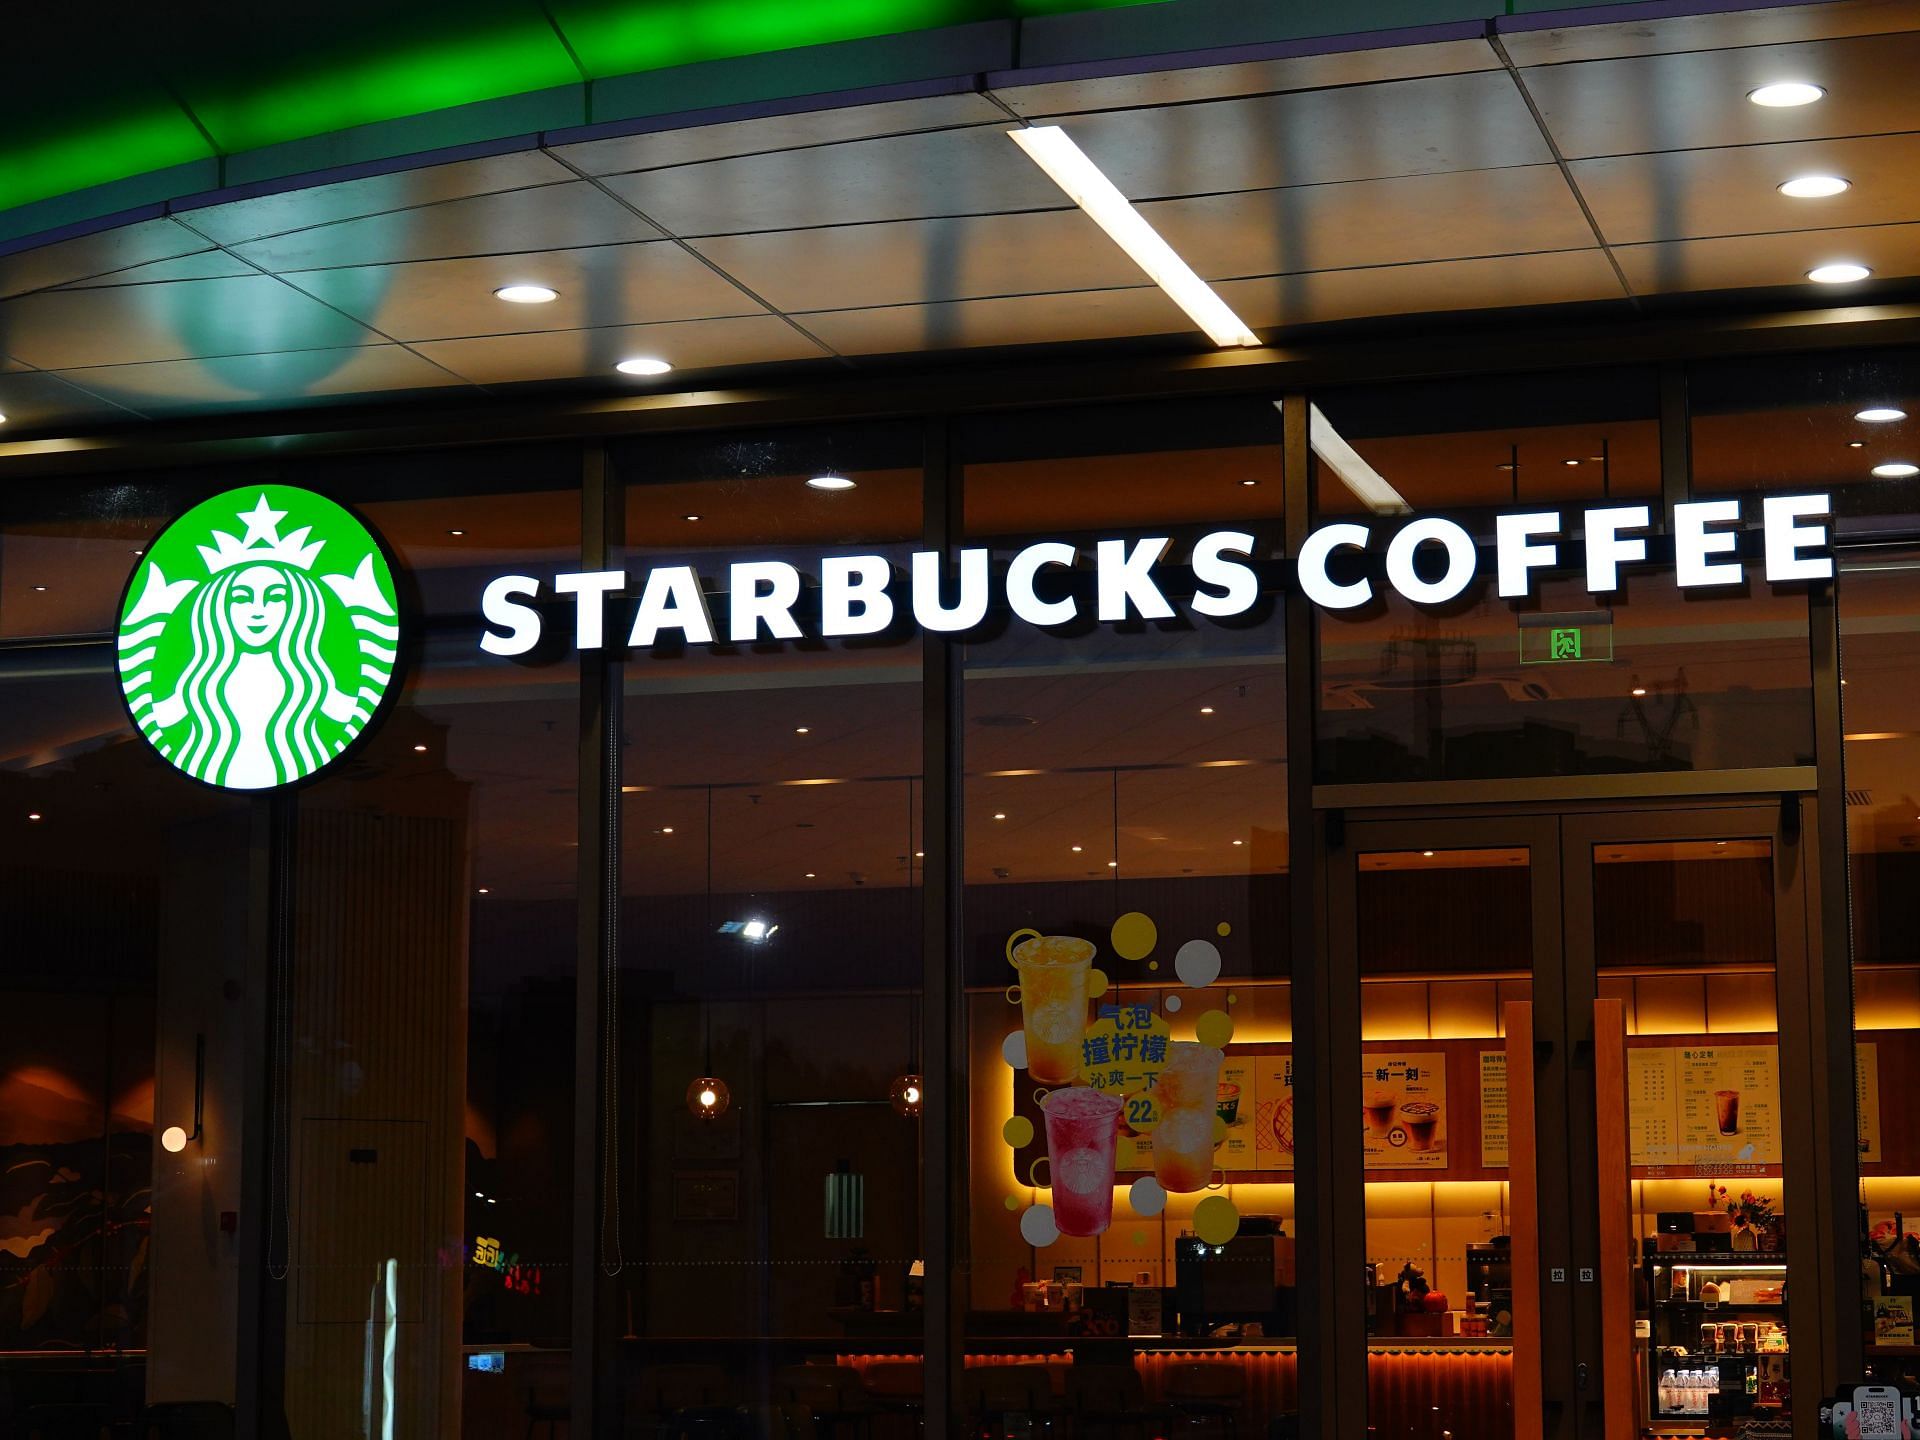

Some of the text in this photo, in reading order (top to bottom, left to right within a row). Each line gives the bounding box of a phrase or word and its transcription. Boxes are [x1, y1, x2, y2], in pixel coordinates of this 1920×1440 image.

[480, 494, 1833, 656] STARBUCKS COFFEE
[1099, 1004, 1153, 1030] 气泡
[1083, 1033, 1167, 1066] 撞柠檬
[1090, 1071, 1158, 1089] 沁爽一下
[1376, 1068, 1419, 1081] 新一刻
[1128, 1100, 1153, 1123] 22
[1553, 1270, 1563, 1280] 拉
[1582, 1270, 1592, 1280] 拉
